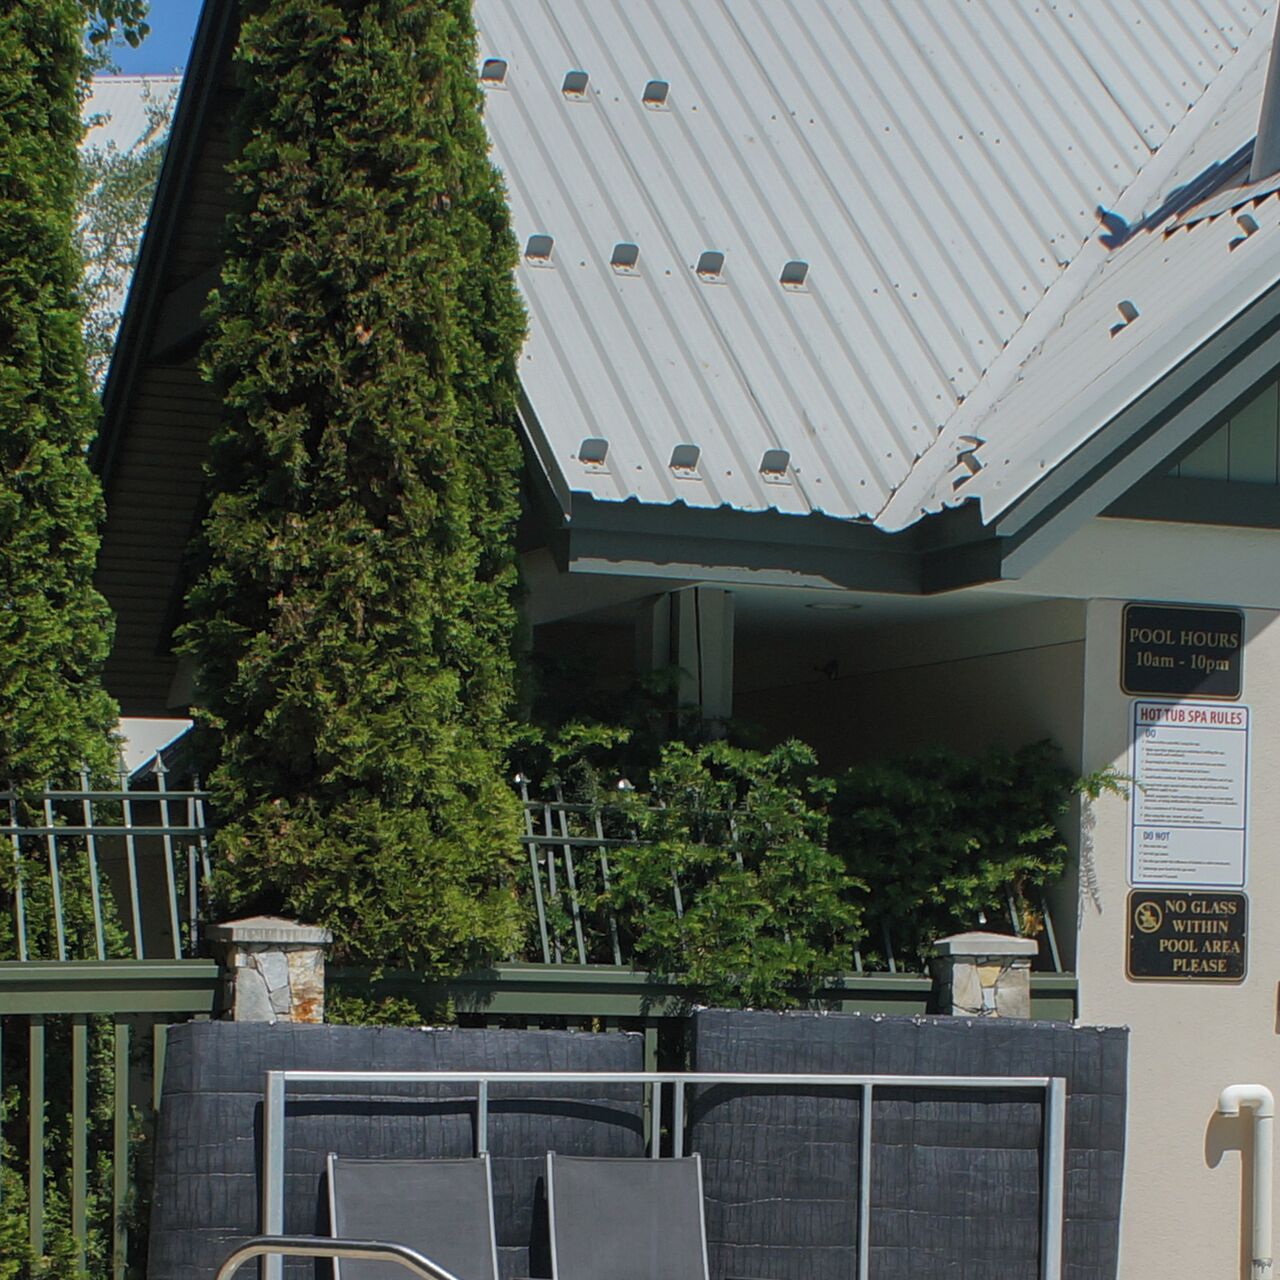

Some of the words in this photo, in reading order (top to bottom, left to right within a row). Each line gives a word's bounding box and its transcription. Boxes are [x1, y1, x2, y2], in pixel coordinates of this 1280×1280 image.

[1129, 628, 1175, 646] POOL
[1180, 631, 1238, 648] HOURS
[1136, 651, 1174, 668] 10am
[1190, 653, 1229, 674] 10pm
[1140, 708, 1162, 721] HOT
[1165, 709, 1185, 723] TUB
[1188, 710, 1208, 723] SPA
[1210, 711, 1242, 725] RULES
[1145, 728, 1157, 738] DO
[1143, 831, 1154, 841] DO
[1155, 832, 1170, 841] NOT
[1164, 900, 1187, 913] NO
[1190, 901, 1237, 915] GLASS
[1172, 920, 1229, 934] WITHIN
[1159, 939, 1198, 952] POOL
[1202, 940, 1241, 953] AREA
[1172, 959, 1227, 972] PLEASE
